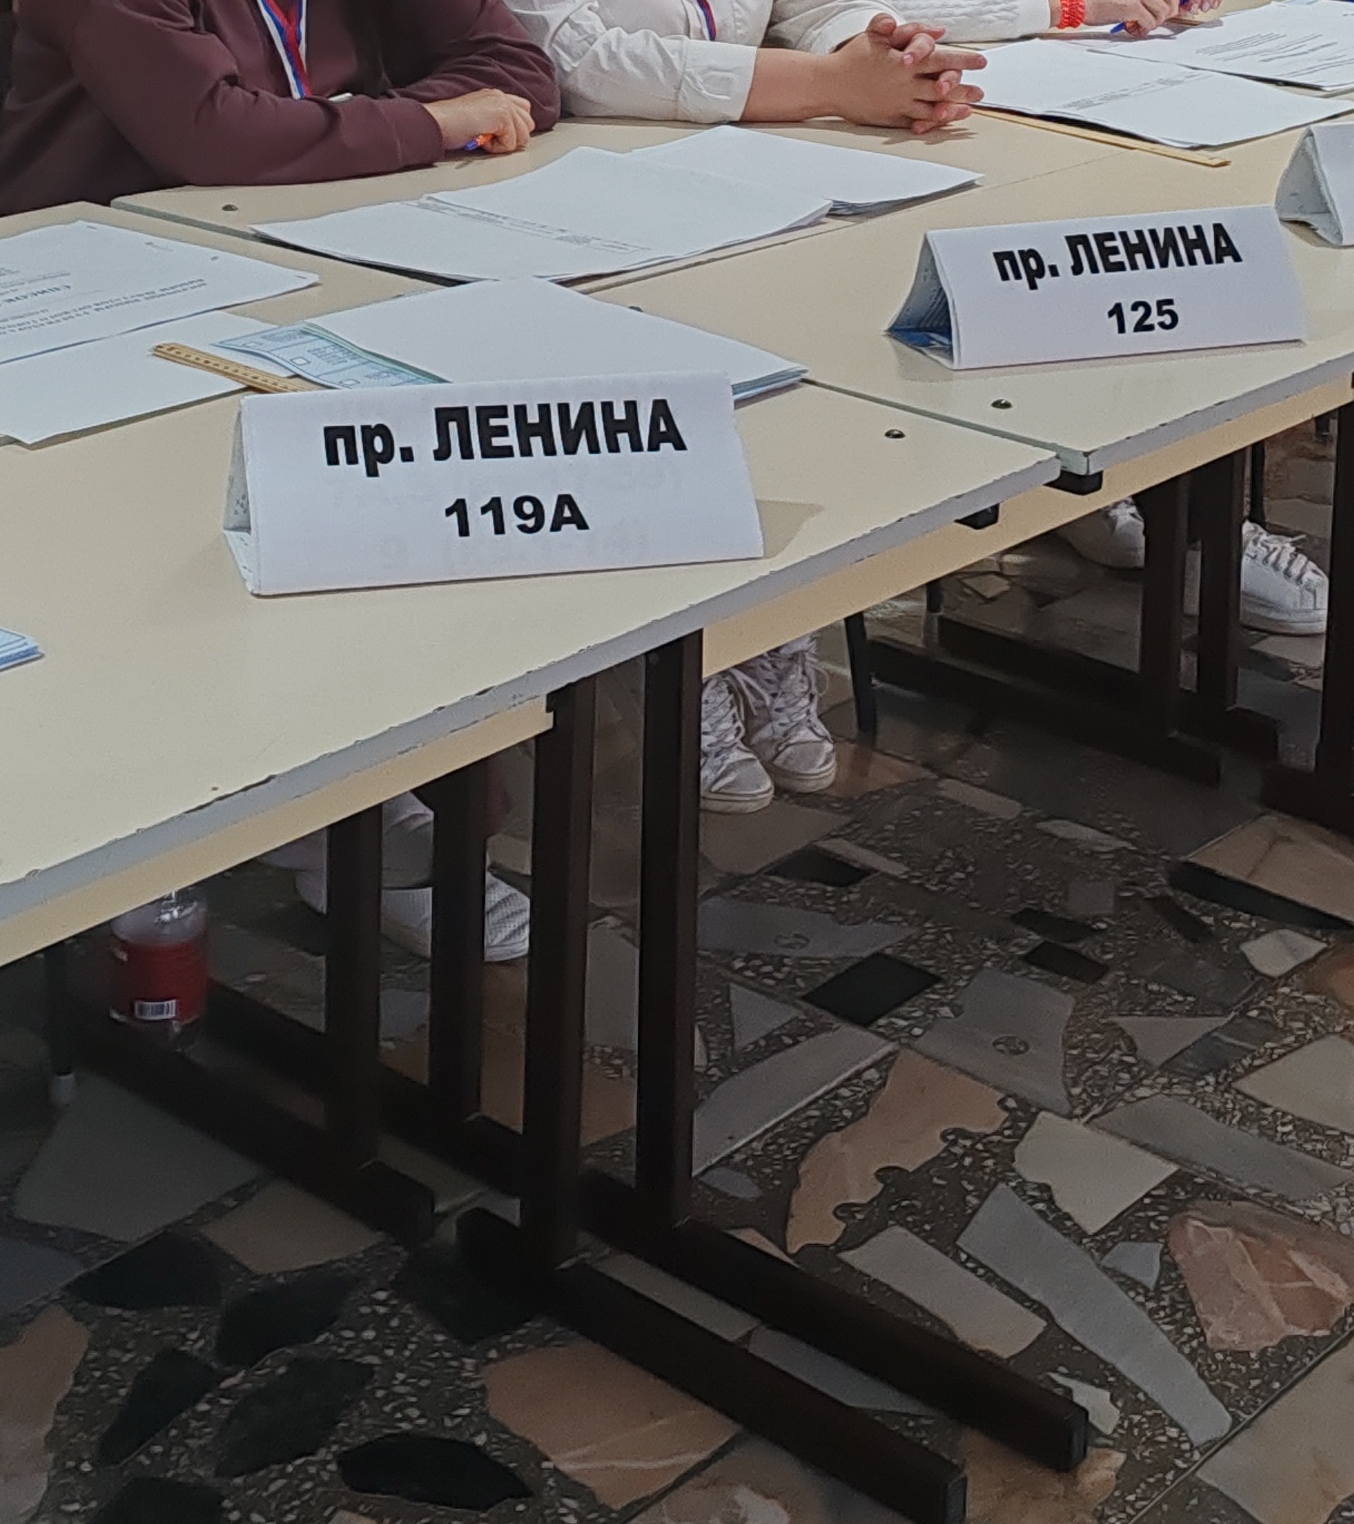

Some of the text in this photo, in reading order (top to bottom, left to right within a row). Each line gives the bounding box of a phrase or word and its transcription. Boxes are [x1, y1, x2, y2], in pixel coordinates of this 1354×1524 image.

[993, 223, 1243, 290] пр. ЛЕНИНА
[1108, 299, 1178, 334] 125
[324, 399, 687, 477] пр. ЛЕНИНА
[445, 494, 589, 537] 119А
